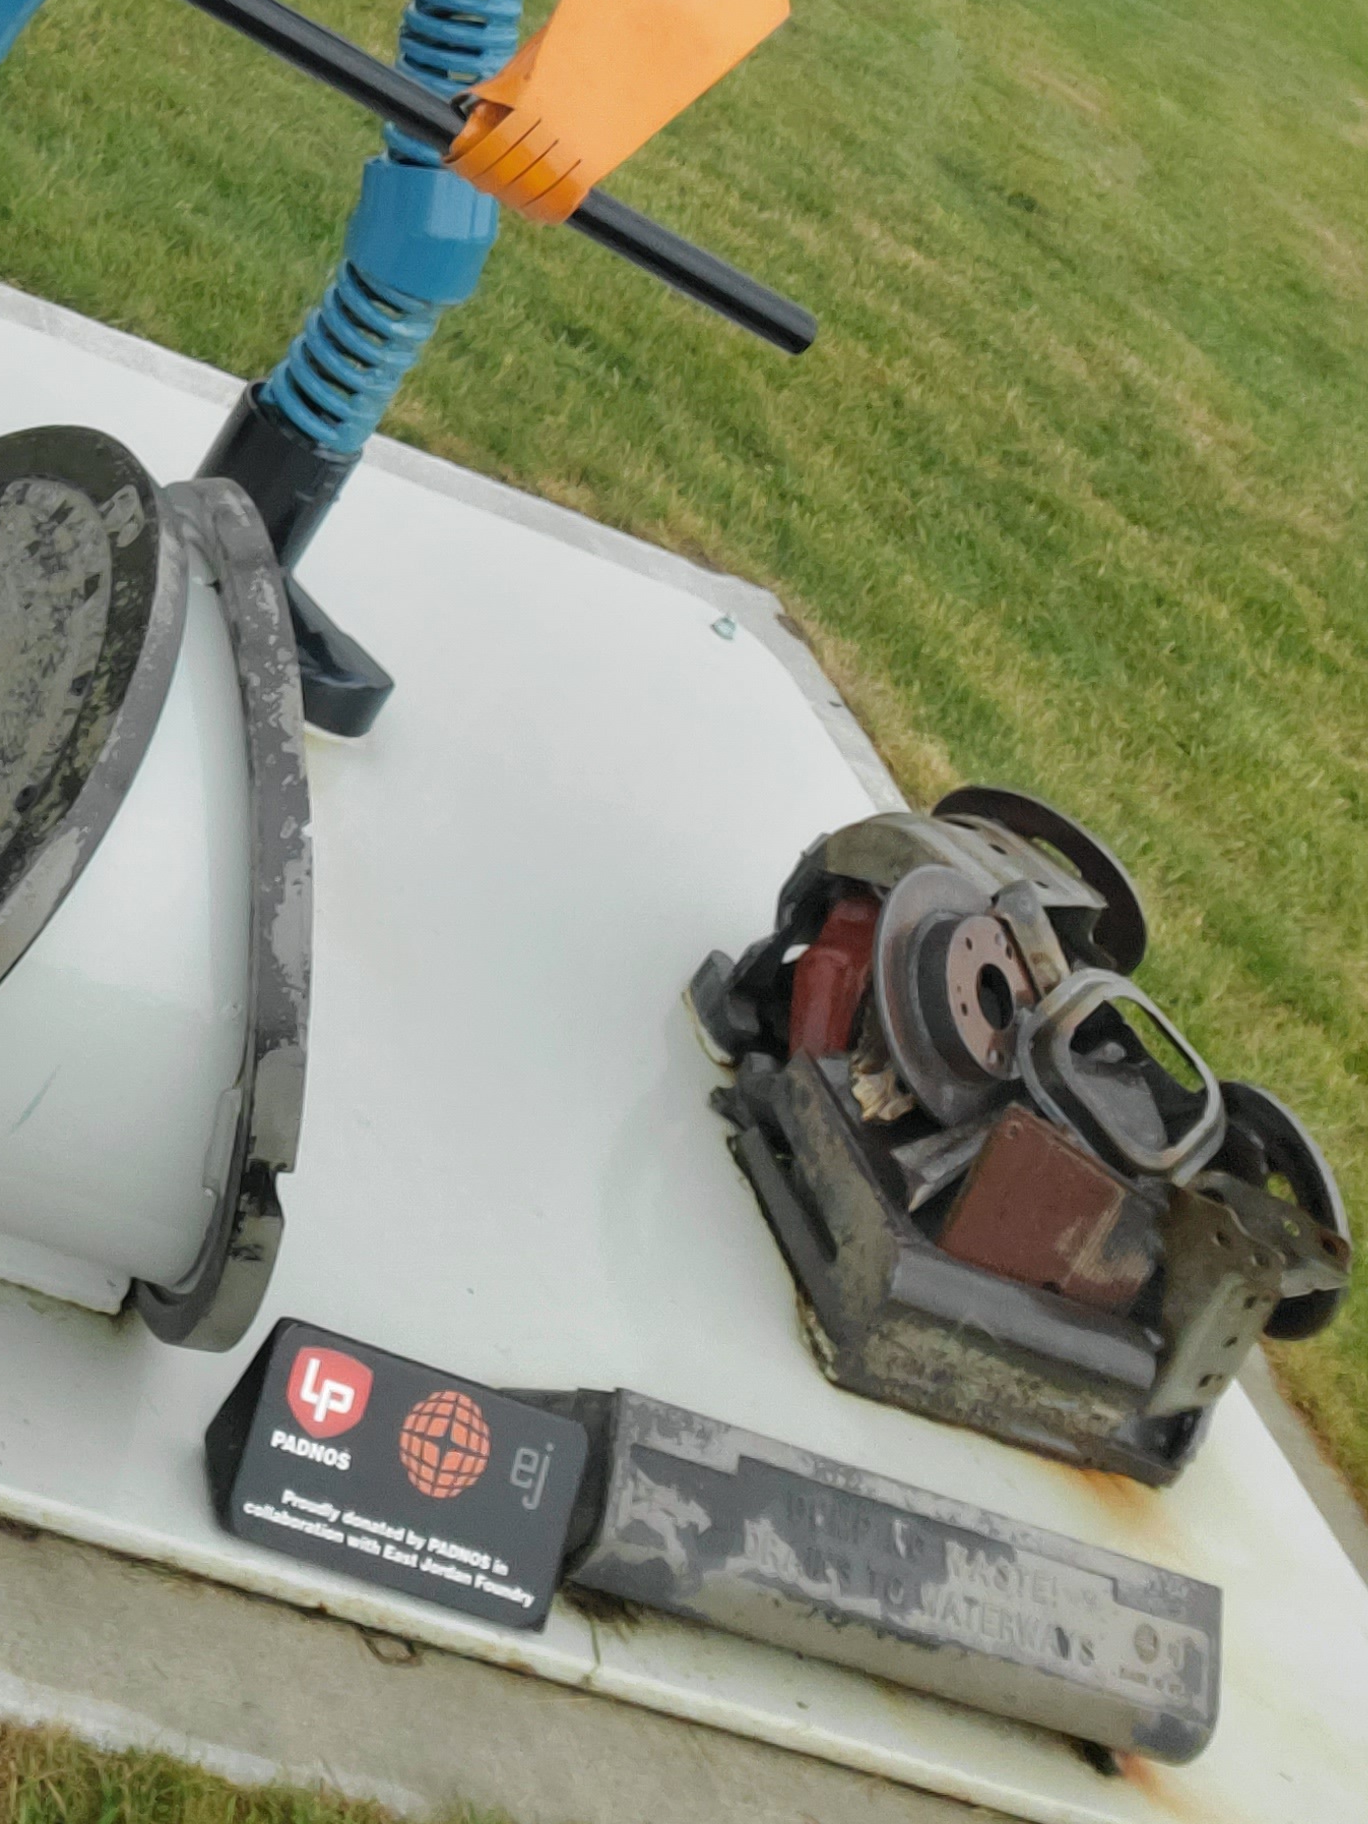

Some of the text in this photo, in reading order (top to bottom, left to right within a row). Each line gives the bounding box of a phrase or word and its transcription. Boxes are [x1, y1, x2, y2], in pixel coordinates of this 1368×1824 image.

[270, 1430, 352, 1471] PADNOS
[243, 1501, 535, 1609] collaboration with East Jordan Foundry
[282, 1488, 509, 1577] Proudly donated by PADNOS in
